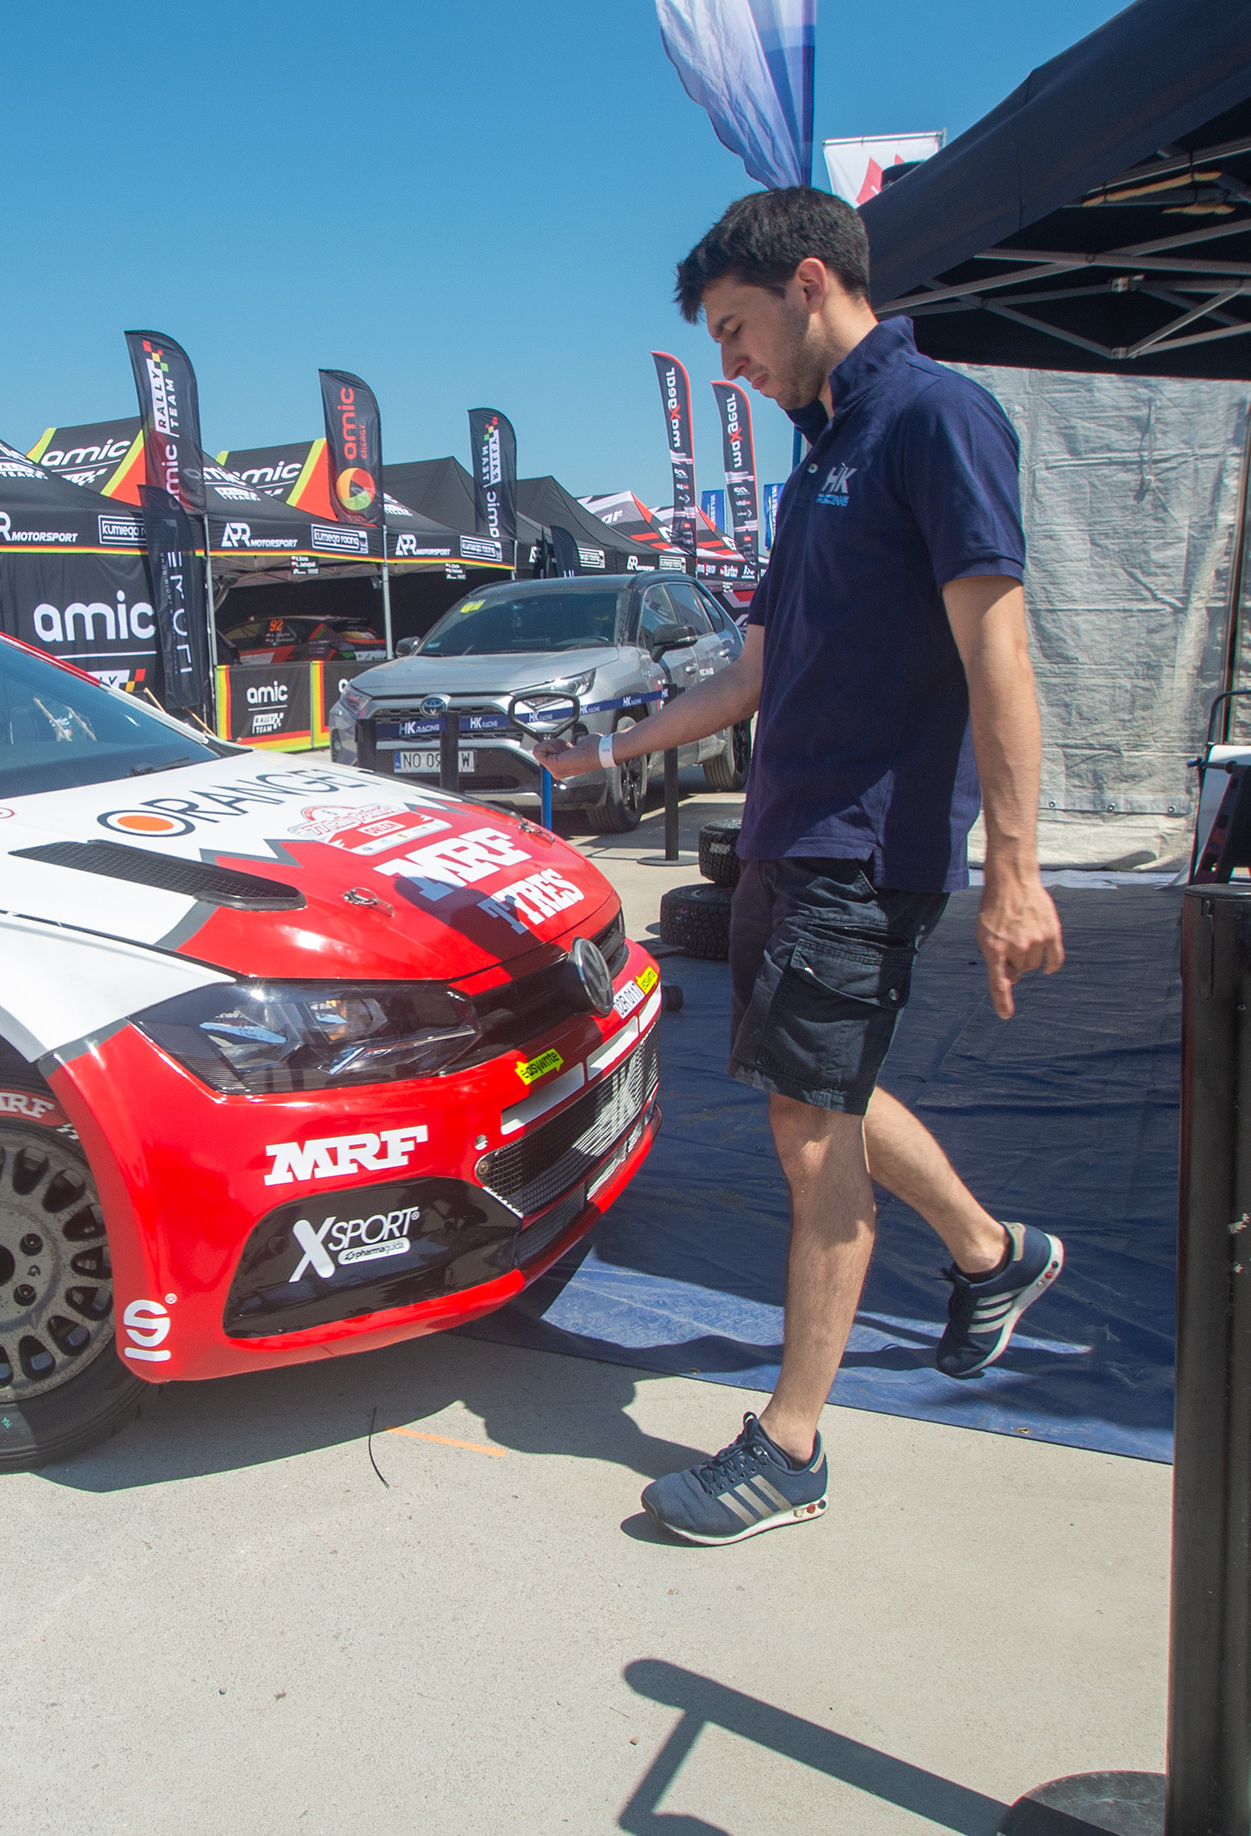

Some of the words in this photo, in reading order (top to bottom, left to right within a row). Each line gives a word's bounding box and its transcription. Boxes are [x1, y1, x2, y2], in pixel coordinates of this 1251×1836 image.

[151, 370, 168, 429] RALLY
[165, 379, 180, 428] TEAM
[338, 387, 356, 460] amic
[41, 439, 132, 467] amic
[241, 461, 303, 481] mic
[821, 466, 858, 494] HK
[11, 531, 79, 543] MOTORSPORT
[102, 523, 140, 540] kumiega
[250, 539, 298, 548] MOTORSPORT
[416, 548, 450, 556] MOTORSPORT
[33, 590, 157, 642] amic
[269, 619, 284, 632] 92
[246, 681, 288, 704] amic
[623, 696, 632, 706] HK
[661, 688, 669, 698] HK
[529, 711, 539, 722] HK
[580, 704, 589, 715] HK
[255, 725, 273, 733] TEAM
[399, 721, 416, 735] HK
[416, 724, 440, 733] RACING
[470, 717, 482, 729] HK
[403, 753, 421, 768] NO
[96, 768, 382, 838] ORANGE1
[373, 827, 532, 901] MRF
[477, 868, 585, 935] TYRES
[264, 1125, 428, 1186] MRF
[355, 1242, 405, 1260] pharmaguida
